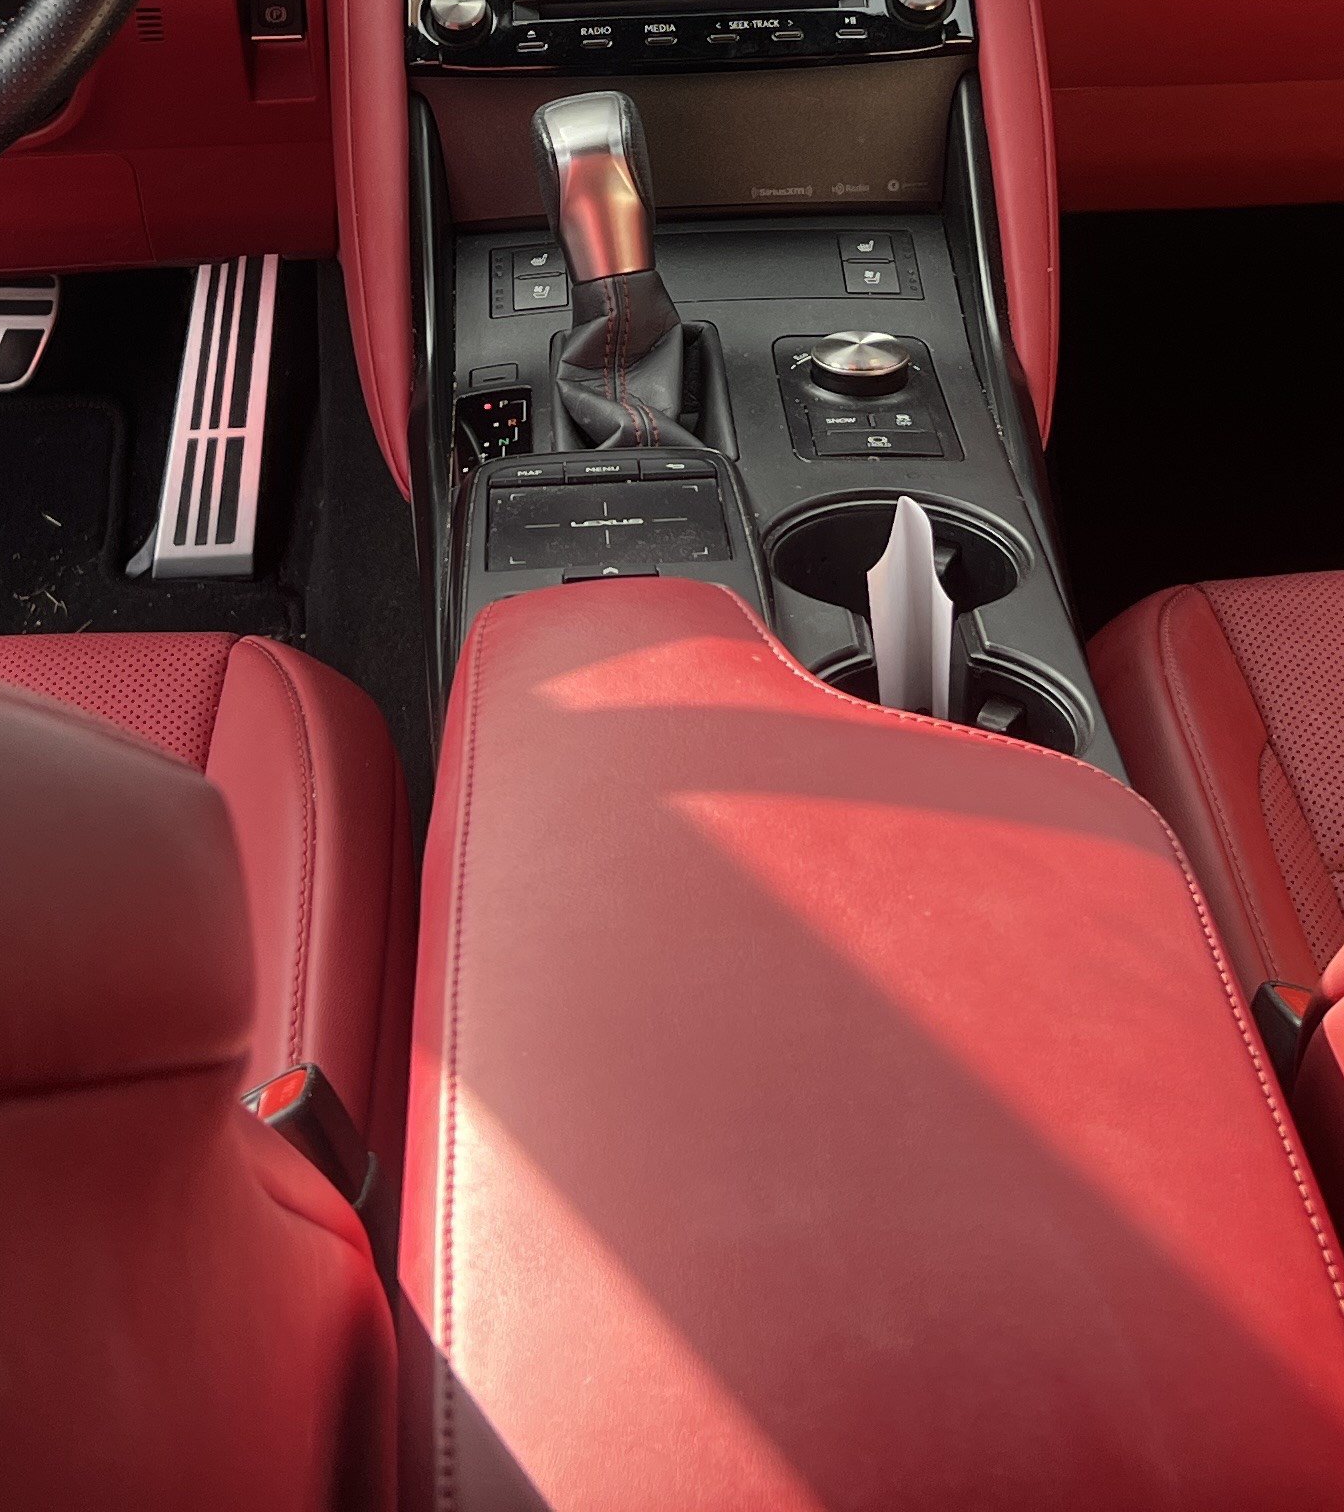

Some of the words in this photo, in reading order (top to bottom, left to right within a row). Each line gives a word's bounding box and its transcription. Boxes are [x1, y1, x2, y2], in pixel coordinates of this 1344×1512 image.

[580, 26, 612, 37] RADIO
[644, 23, 676, 34] MEDIA
[825, 416, 857, 425] SNOW
[517, 469, 543, 477] MAP
[584, 465, 620, 473] MENU
[570, 517, 644, 528] LEXUS
